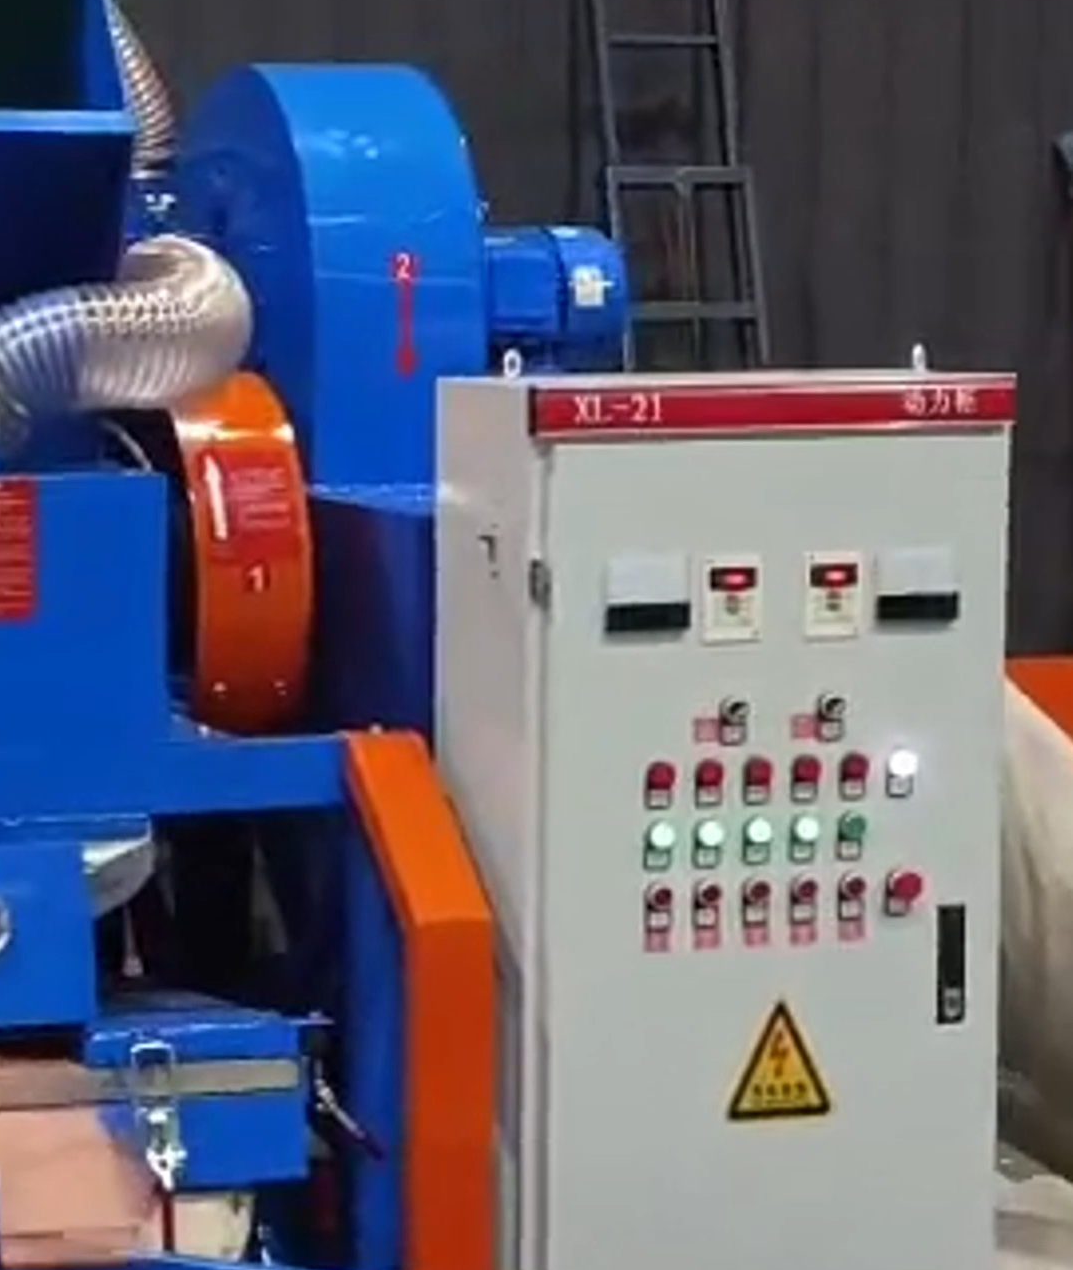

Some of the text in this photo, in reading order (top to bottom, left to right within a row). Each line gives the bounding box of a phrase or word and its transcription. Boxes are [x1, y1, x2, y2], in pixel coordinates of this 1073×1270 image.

[395, 251, 411, 280] 2
[573, 392, 663, 425] XL-21
[248, 563, 265, 592] 1
